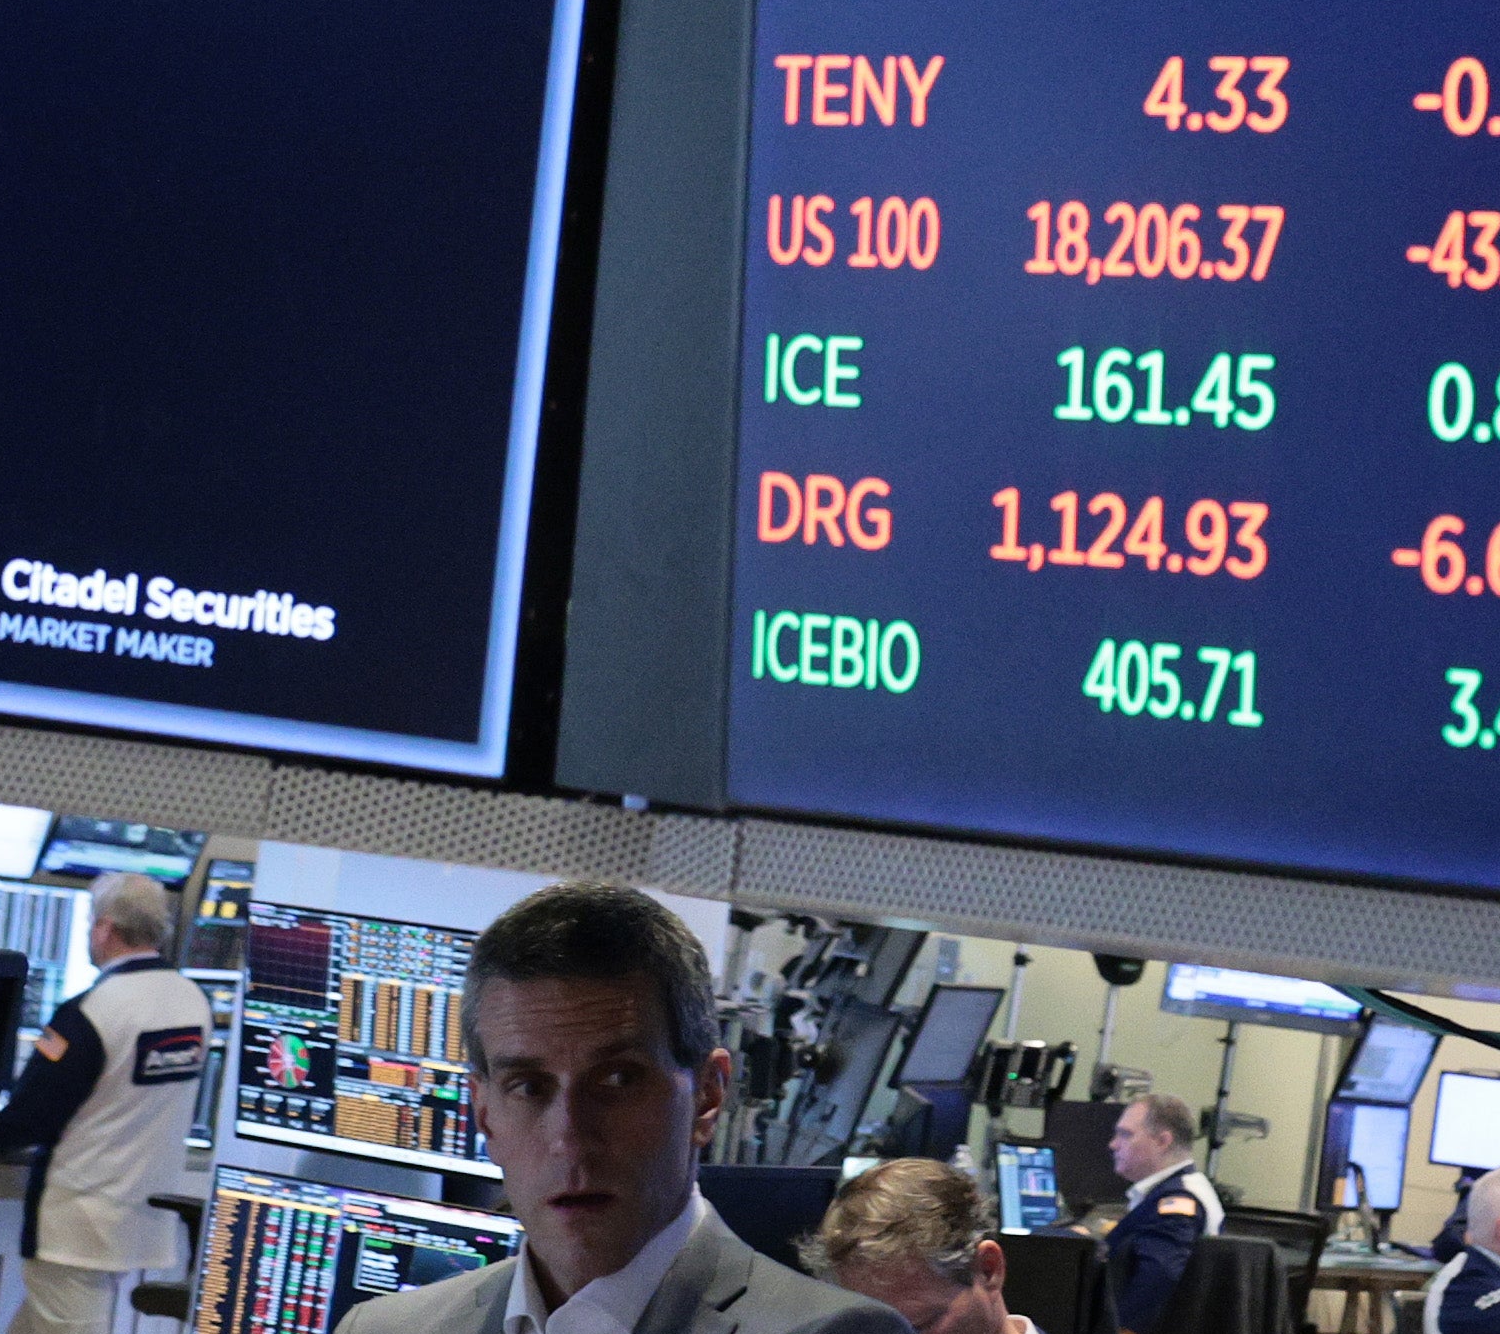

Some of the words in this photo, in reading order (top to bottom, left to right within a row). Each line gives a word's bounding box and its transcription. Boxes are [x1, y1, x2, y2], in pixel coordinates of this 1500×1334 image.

[777, 49, 947, 127] TENY
[1143, 56, 1290, 133] 4.33
[770, 195, 835, 266] US
[849, 197, 940, 271] 100
[1025, 201, 1284, 285] 18,206.37
[765, 333, 863, 407] ICE
[1054, 346, 1275, 430] 161.45
[760, 471, 892, 550] DRG
[990, 487, 1269, 579] 1,124.93
[1, 558, 139, 616] Citadel
[144, 576, 336, 641] Securities
[114, 627, 215, 668] MAKER
[755, 610, 920, 693] ICEBIO
[1083, 639, 1263, 727] 405.71
